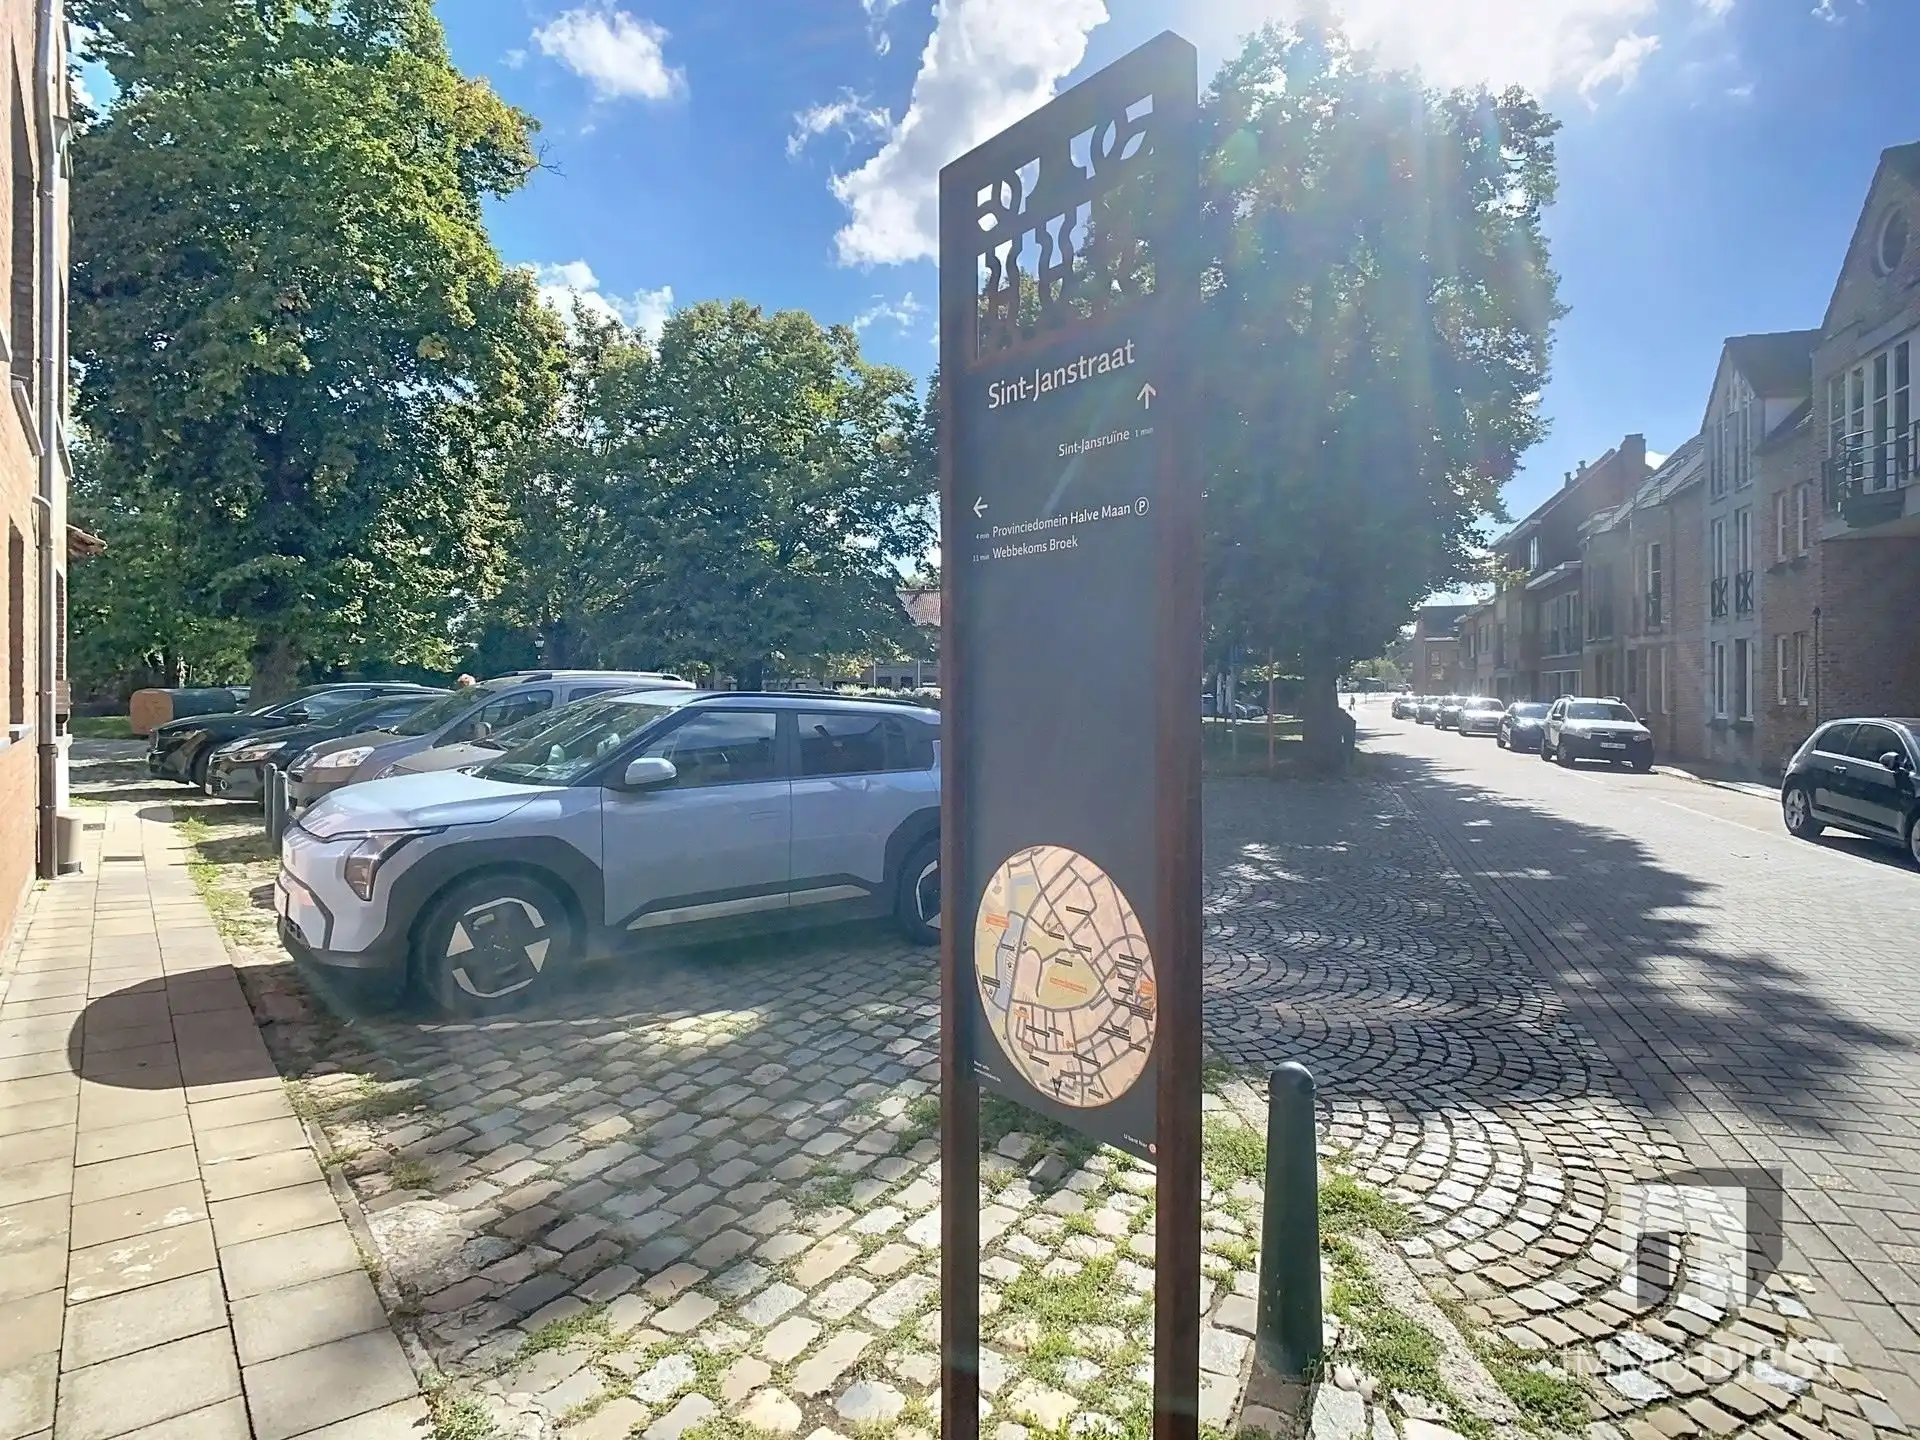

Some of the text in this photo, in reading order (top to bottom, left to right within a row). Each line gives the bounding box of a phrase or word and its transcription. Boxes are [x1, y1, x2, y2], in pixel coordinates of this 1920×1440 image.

[988, 338, 1135, 409] Sint-Janstraat
[1058, 429, 1130, 457] Sint-Jansruïne
[992, 514, 1068, 538] Provinciedomein
[1070, 509, 1099, 525] Halve
[1101, 503, 1131, 519] Maan
[992, 540, 1048, 559] Webbekoms
[1049, 535, 1078, 551] Broek
